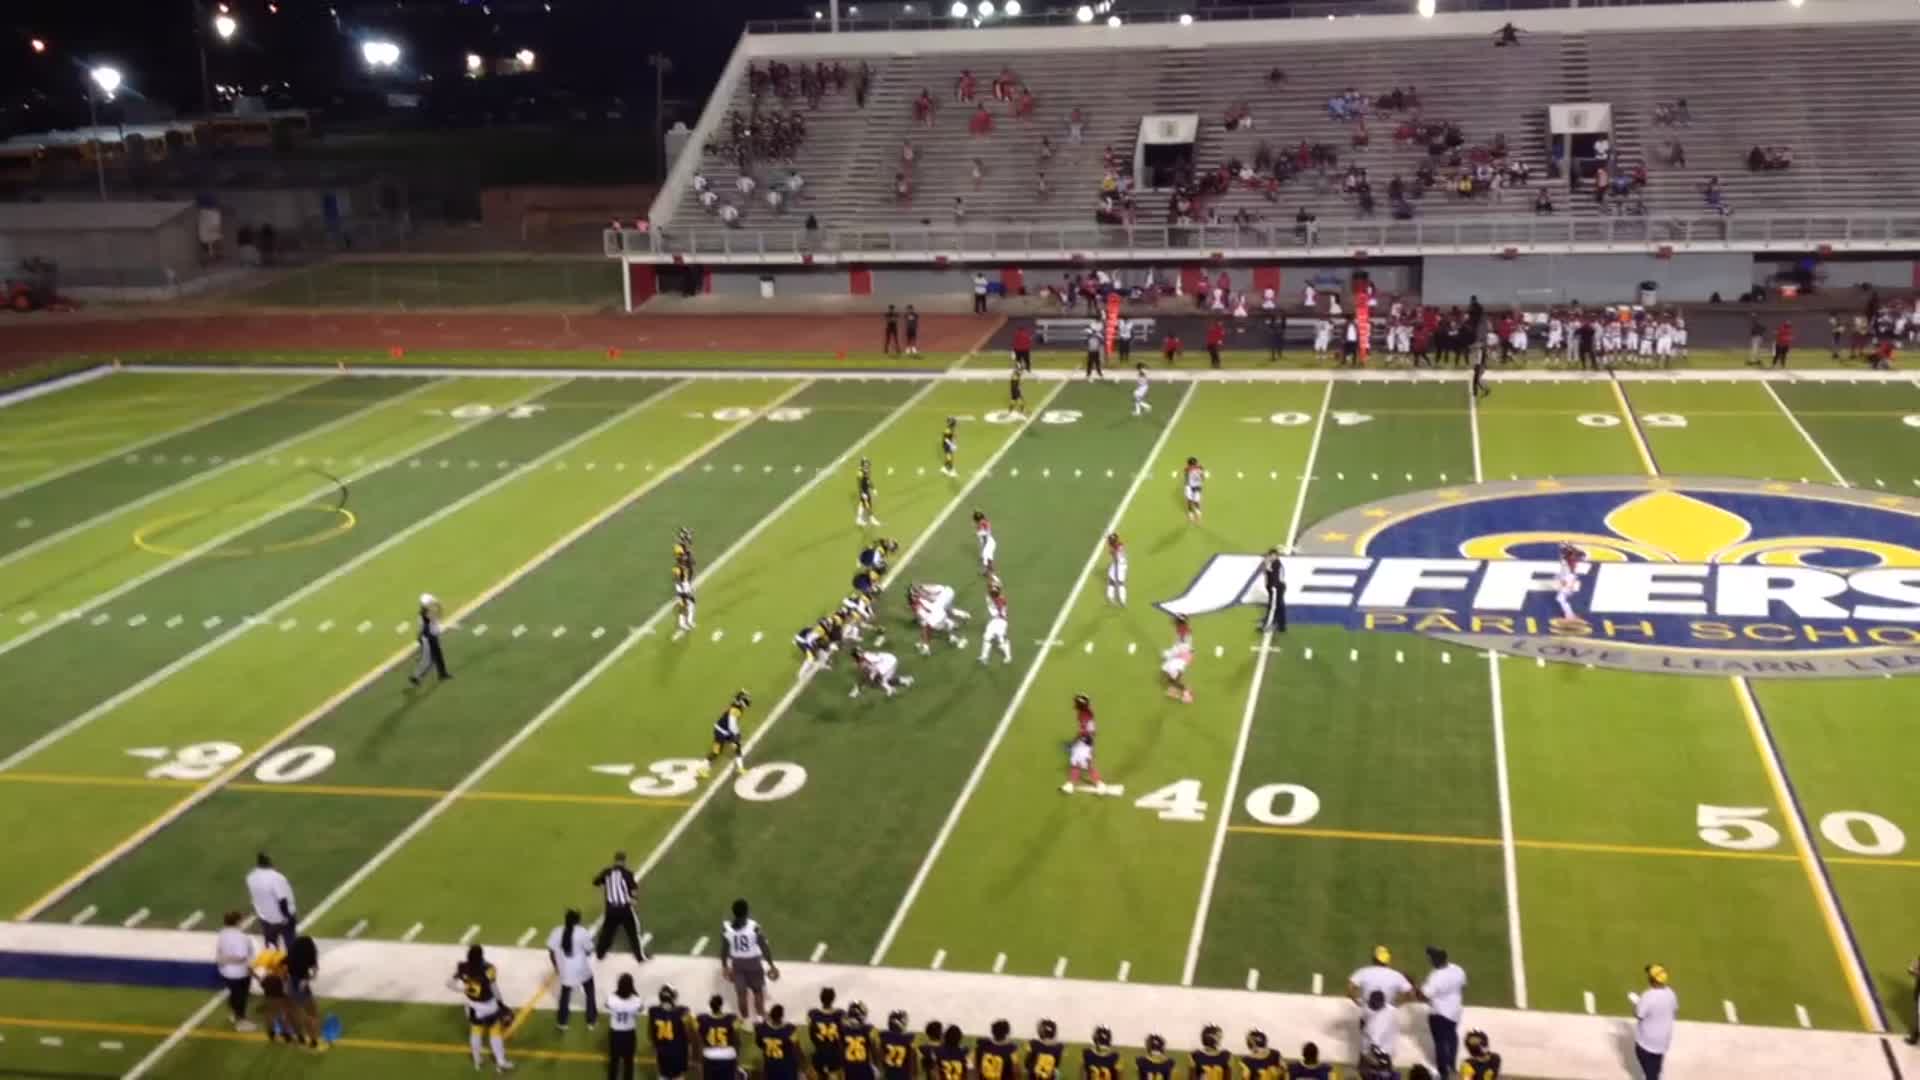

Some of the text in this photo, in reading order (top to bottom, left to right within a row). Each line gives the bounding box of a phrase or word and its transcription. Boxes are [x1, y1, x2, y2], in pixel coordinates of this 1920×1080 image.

[1365, 612, 1655, 637] PARISH
[1661, 655, 1818, 673] LEARN
[628, 758, 808, 801] 30
[1134, 784, 1321, 826] 40
[1696, 803, 1907, 856] 50
